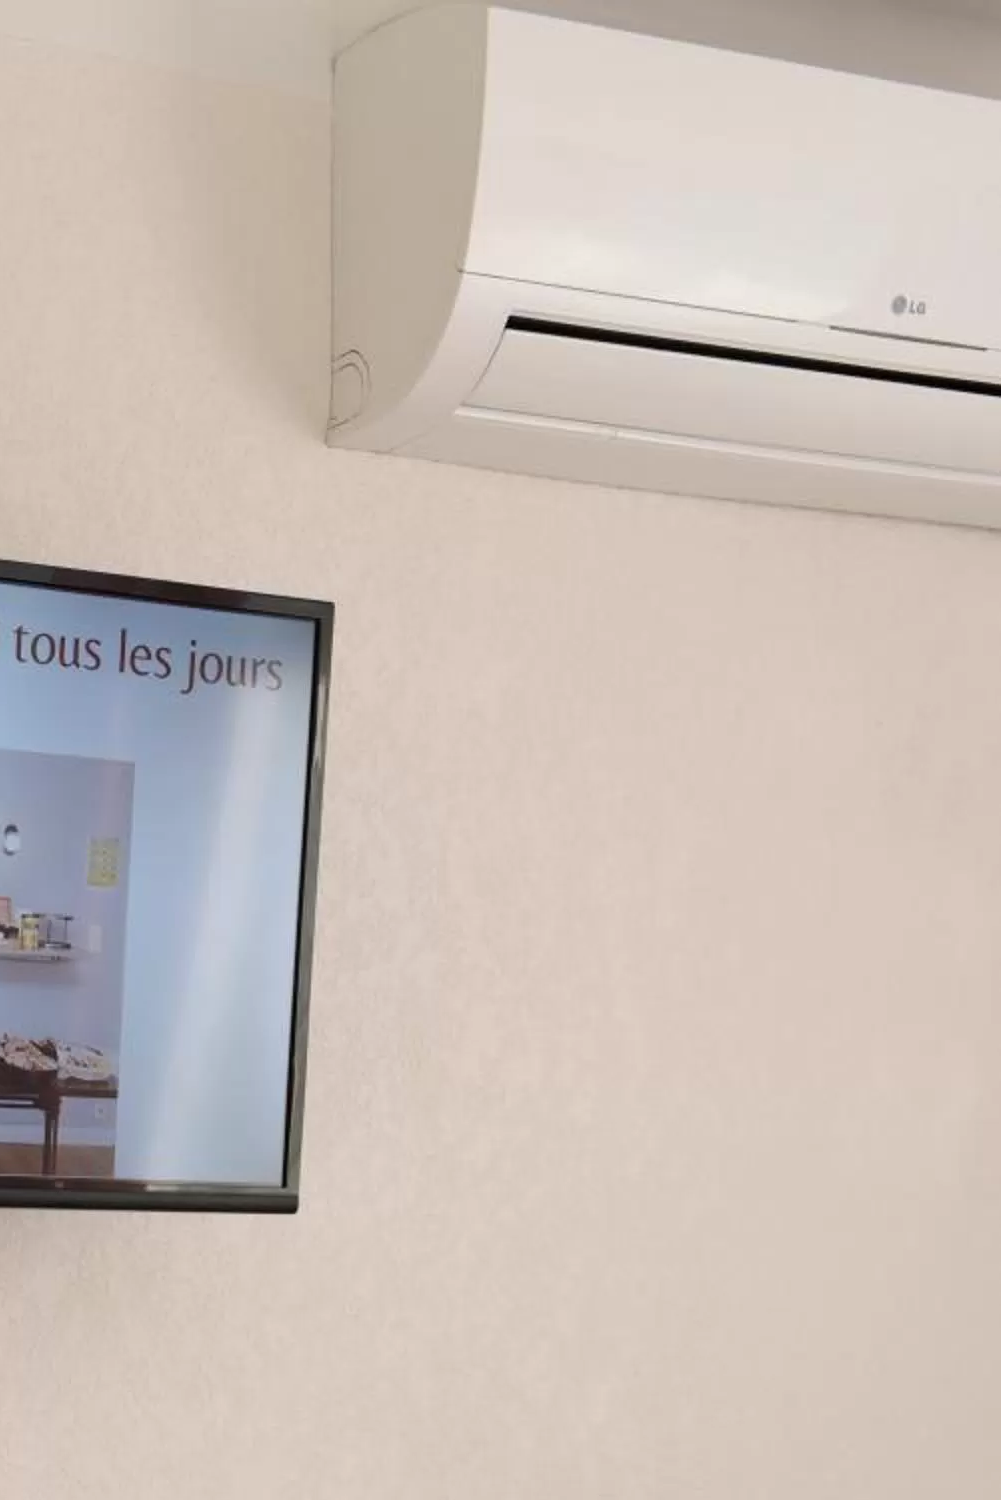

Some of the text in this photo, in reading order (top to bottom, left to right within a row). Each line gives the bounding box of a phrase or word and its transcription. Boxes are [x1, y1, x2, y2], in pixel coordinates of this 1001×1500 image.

[909, 299, 926, 315] LG
[13, 624, 102, 671] tous
[118, 628, 171, 680] les
[180, 639, 284, 695] jours
